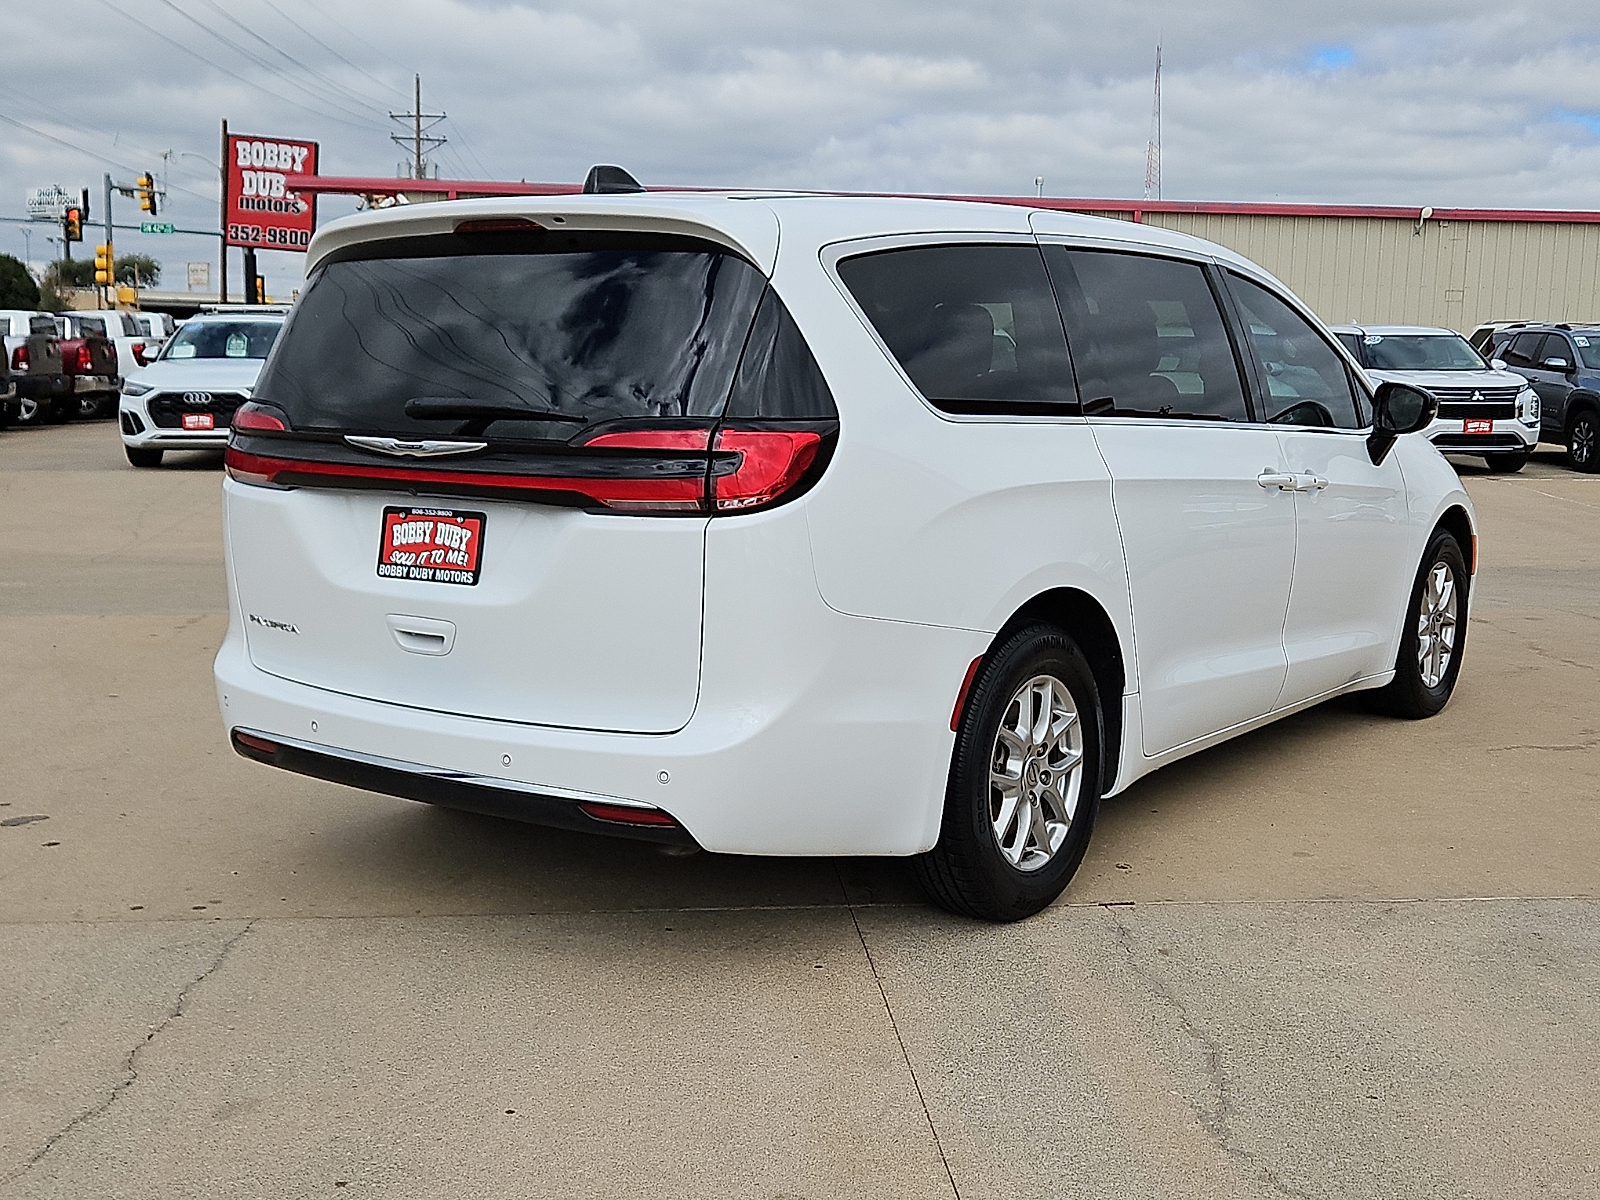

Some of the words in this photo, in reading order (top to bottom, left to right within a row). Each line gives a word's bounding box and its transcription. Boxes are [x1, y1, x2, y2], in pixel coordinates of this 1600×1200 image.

[236, 141, 308, 172] BOBBY
[242, 170, 295, 200] DUB
[239, 196, 302, 214] motors
[229, 224, 310, 246] 352-9800
[392, 521, 434, 547] BOBBY
[434, 522, 472, 551] DUBY
[389, 550, 416, 566] SOLD
[416, 551, 430, 566] IT
[430, 549, 445, 564] TO
[445, 549, 469, 567] ME!
[379, 564, 409, 578] BOBBY
[409, 566, 434, 580] DUBY
[435, 569, 474, 584] MOTORS
